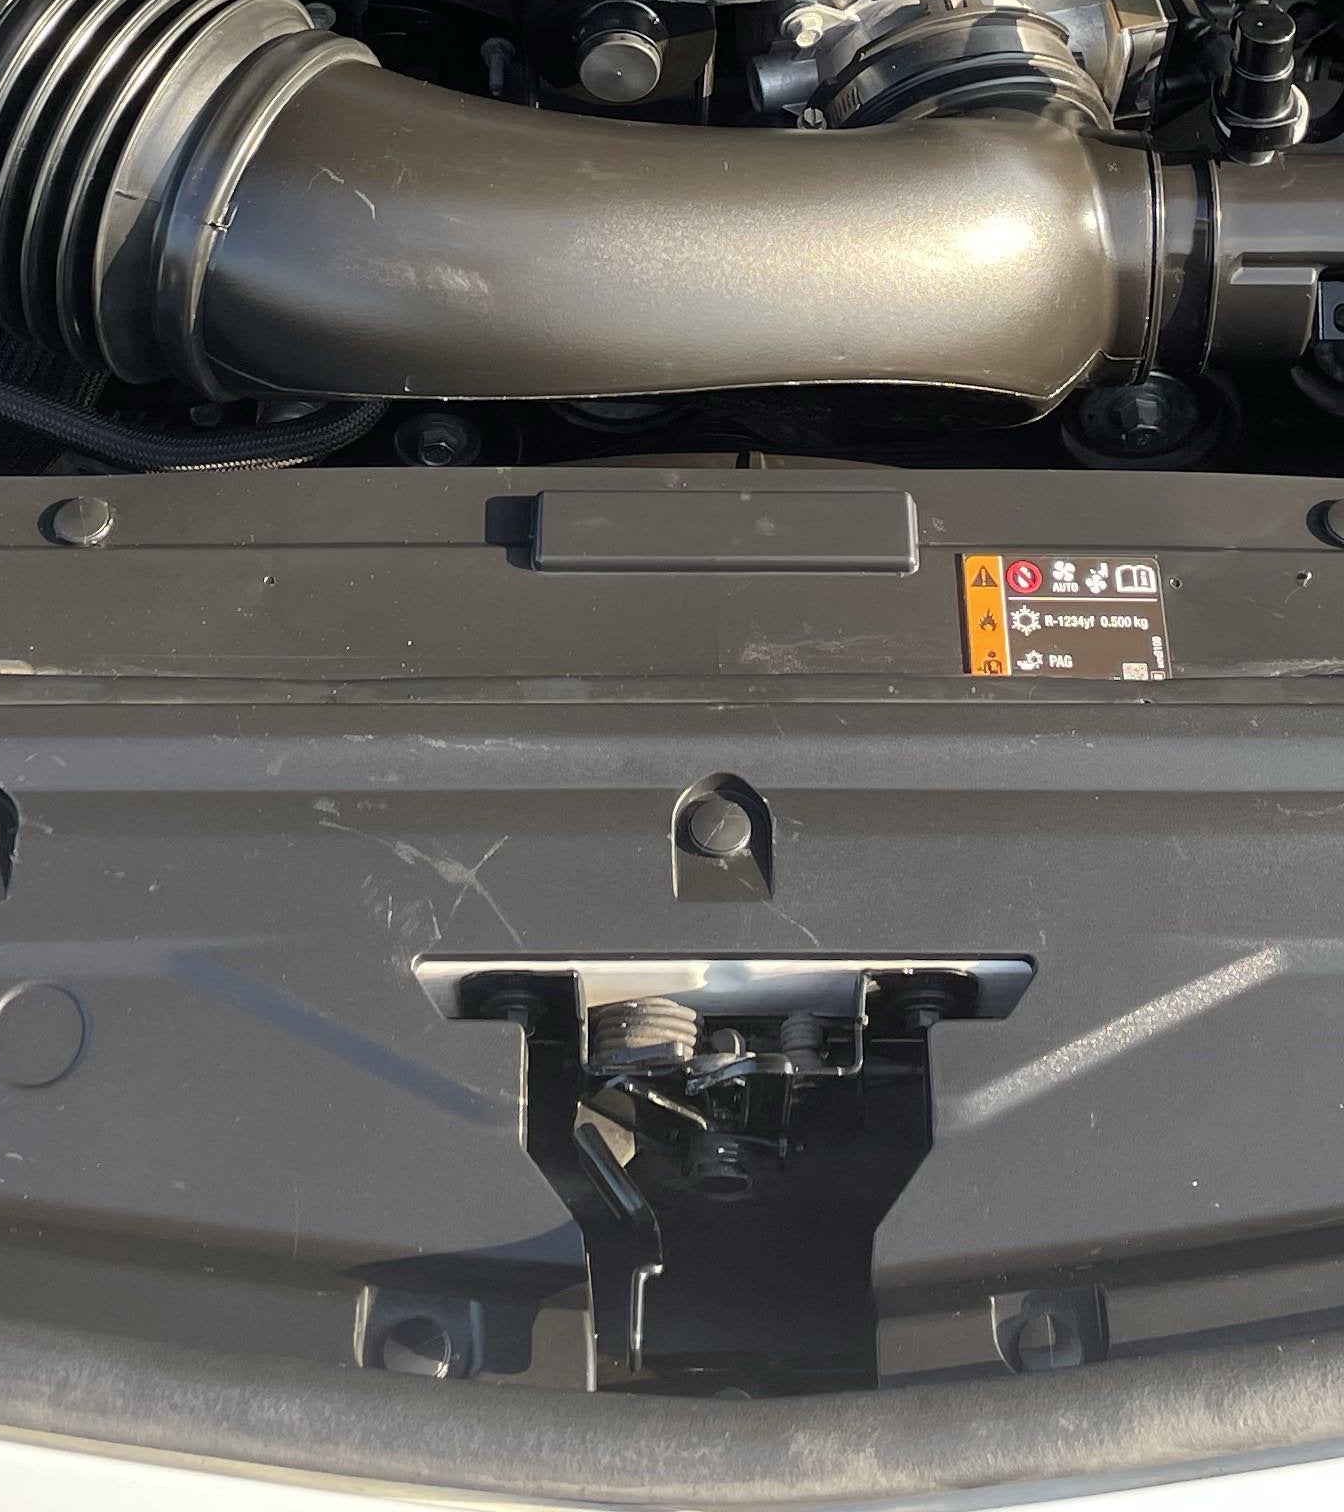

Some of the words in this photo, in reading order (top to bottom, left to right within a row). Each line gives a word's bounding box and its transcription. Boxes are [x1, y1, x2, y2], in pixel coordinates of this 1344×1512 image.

[1052, 582, 1078, 593] AUTO
[1044, 615, 1095, 630] R-1234yf
[1100, 616, 1132, 628] 0.500
[1134, 616, 1149, 631] kg
[1048, 655, 1073, 669] PAG
